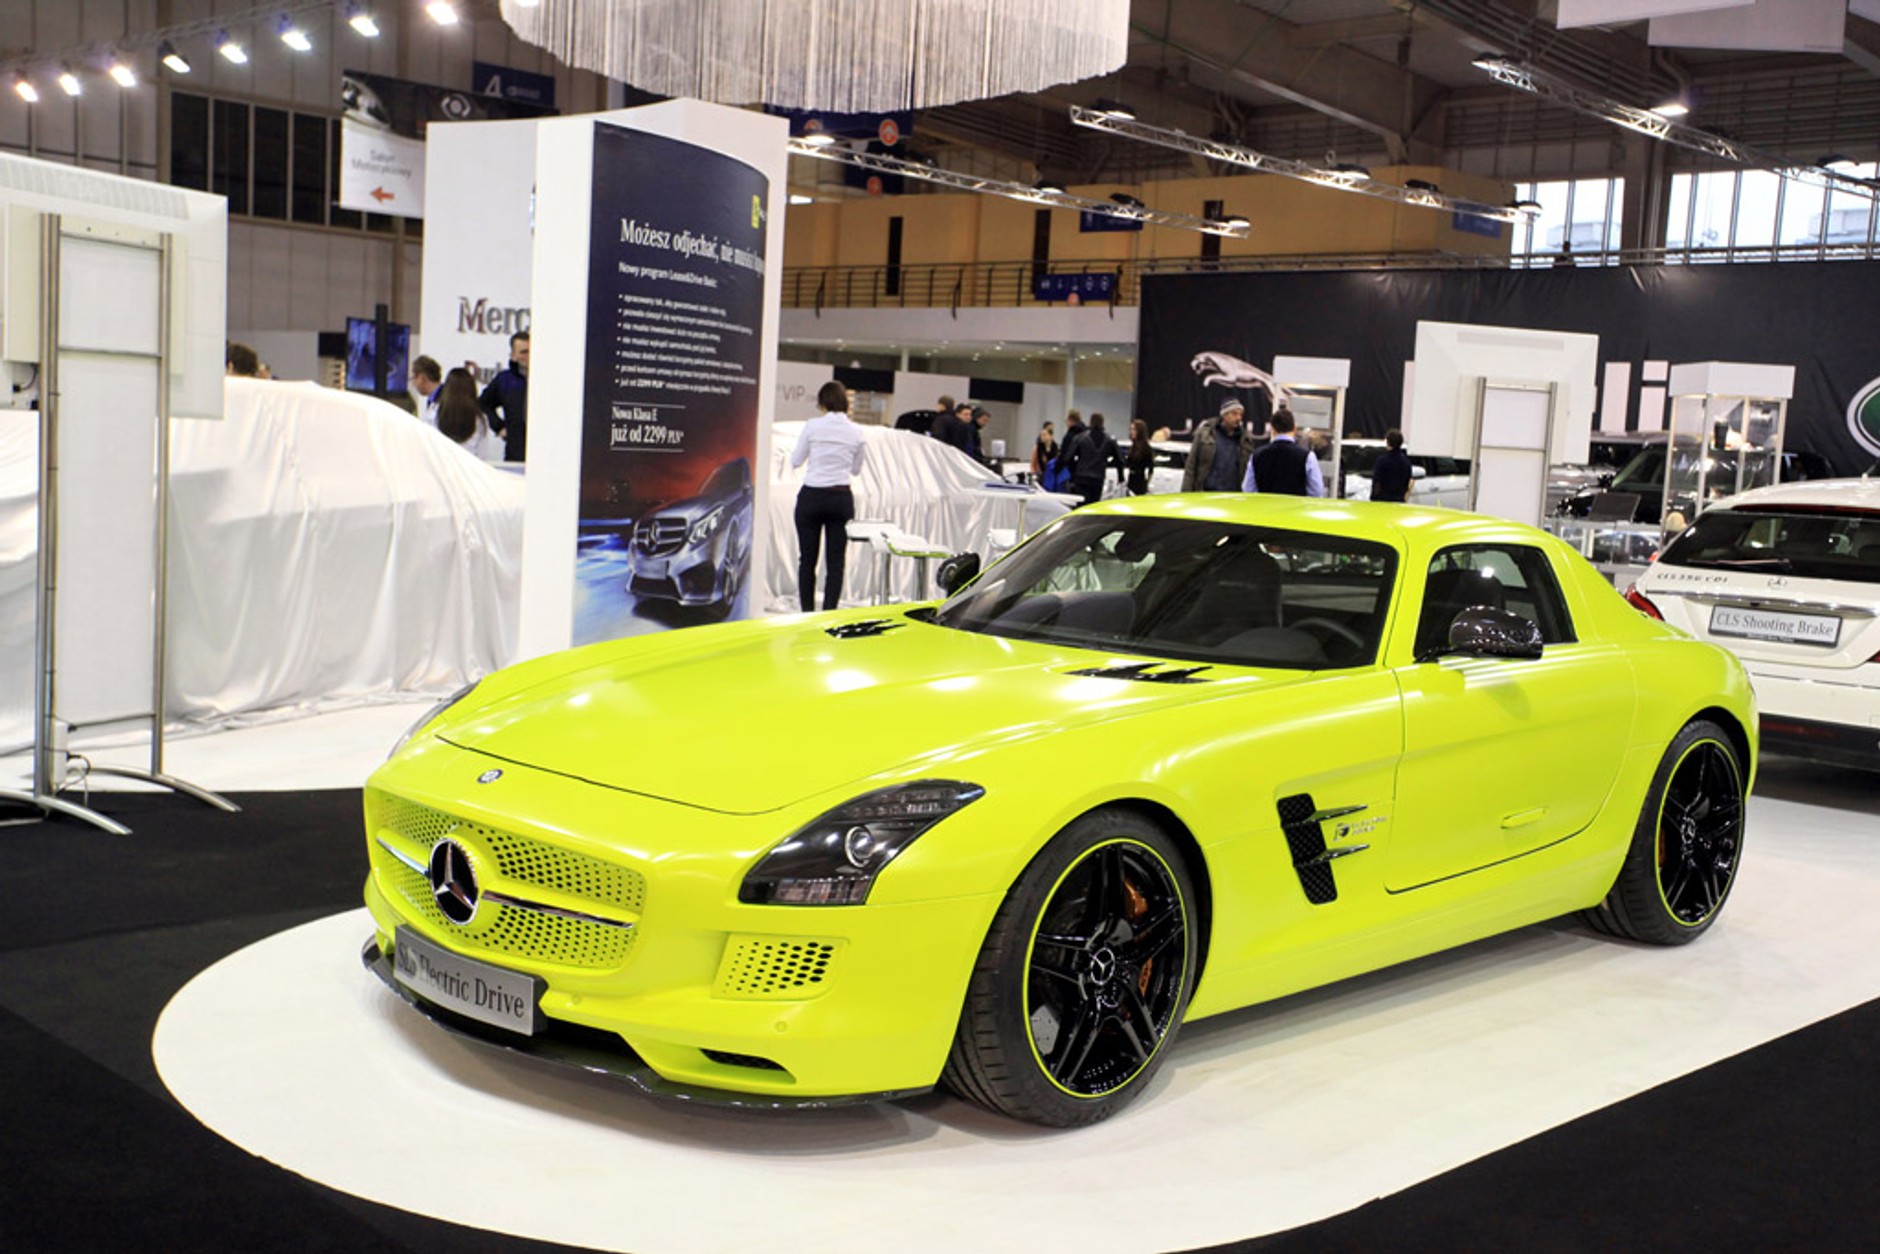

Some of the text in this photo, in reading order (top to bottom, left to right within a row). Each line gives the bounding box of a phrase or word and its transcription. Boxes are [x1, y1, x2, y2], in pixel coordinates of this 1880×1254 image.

[620, 218, 671, 250] Możesz
[610, 423, 628, 446] już
[629, 424, 642, 443] od
[643, 425, 667, 444] 2299
[1716, 611, 1834, 636] CLS Shooting Brake
[419, 953, 470, 1003] Electric
[474, 977, 525, 1019] Drive
